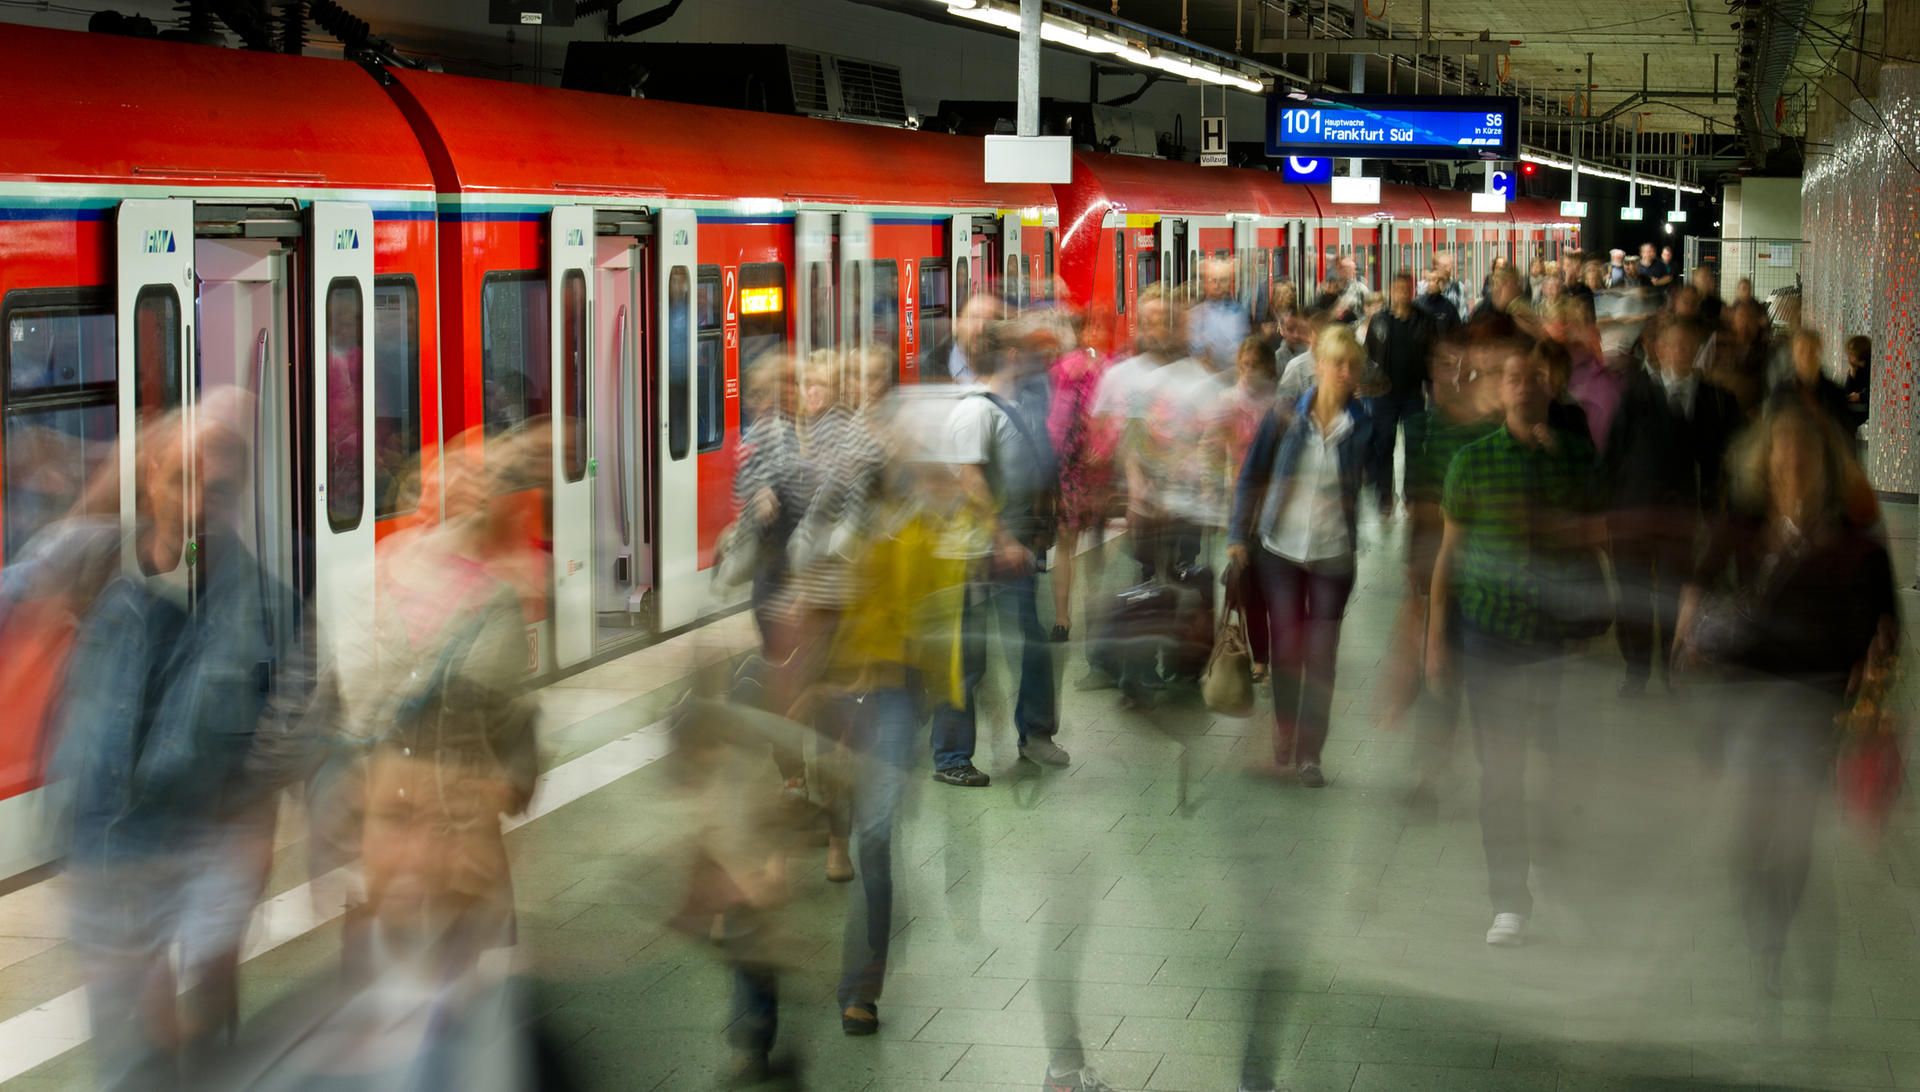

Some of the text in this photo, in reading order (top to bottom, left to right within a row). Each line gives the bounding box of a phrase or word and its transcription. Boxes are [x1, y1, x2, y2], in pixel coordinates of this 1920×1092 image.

[1283, 110, 1320, 133] 101
[1324, 119, 1364, 127] Hauptwache
[1486, 113, 1502, 126] S6
[1203, 119, 1223, 150] H
[1324, 127, 1413, 141] Frankfurt Süd
[1492, 171, 1507, 195] C
[905, 263, 913, 304] 2
[726, 271, 735, 321] 2
